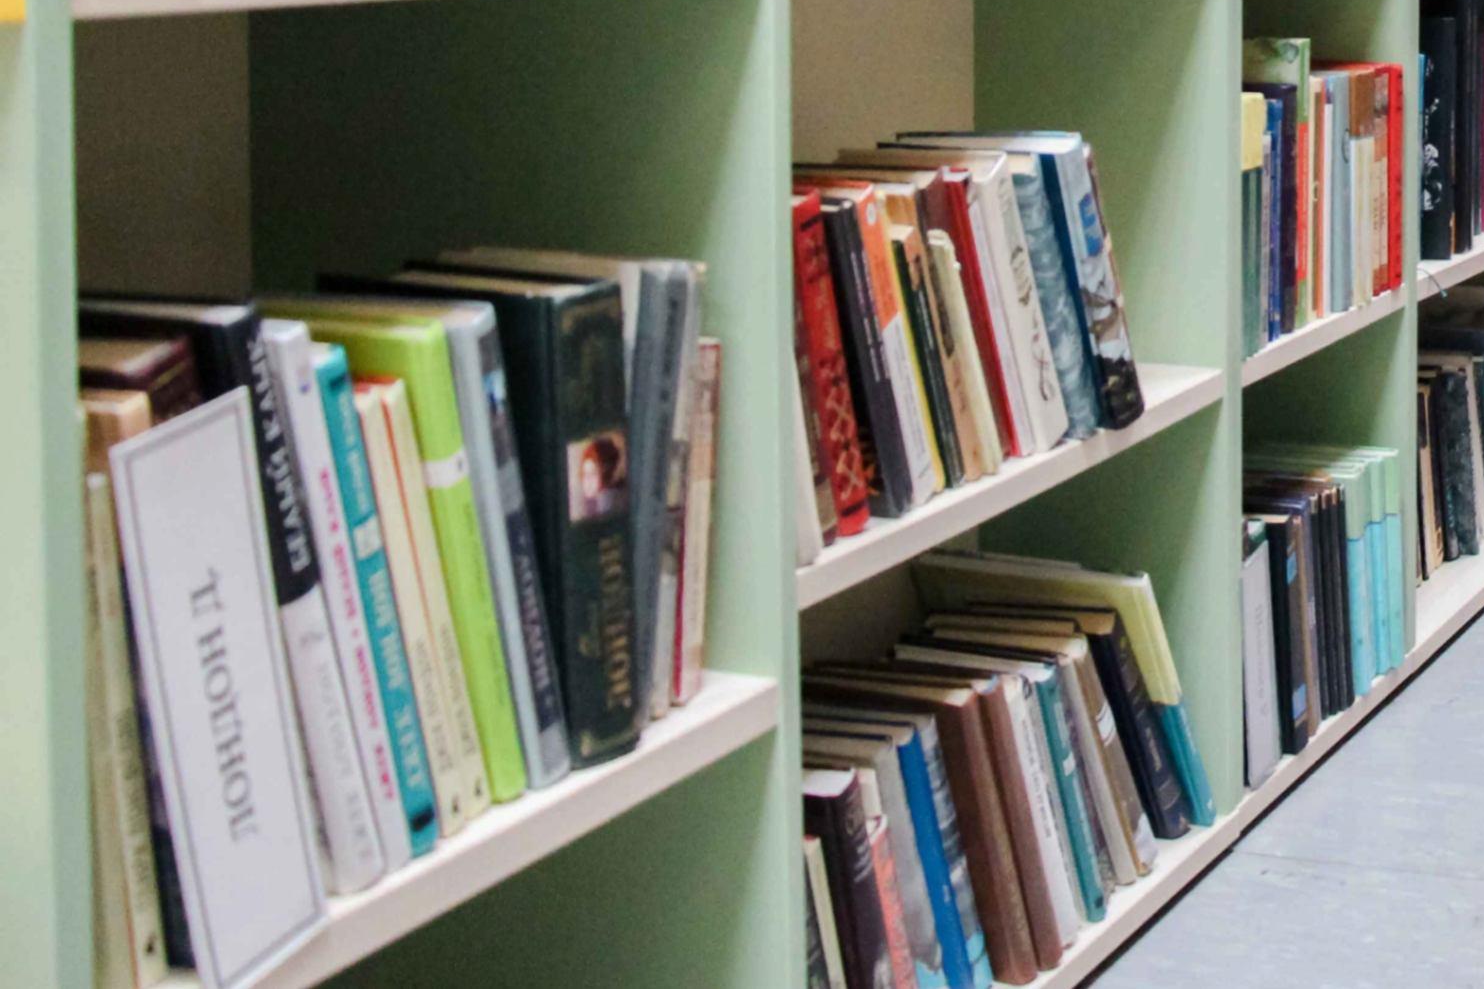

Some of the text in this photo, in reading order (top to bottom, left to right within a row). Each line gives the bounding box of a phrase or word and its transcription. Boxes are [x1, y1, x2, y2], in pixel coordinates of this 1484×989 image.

[264, 446, 313, 572] БЕЛЫЙ
[189, 567, 261, 846] ЛОНДОН Д.
